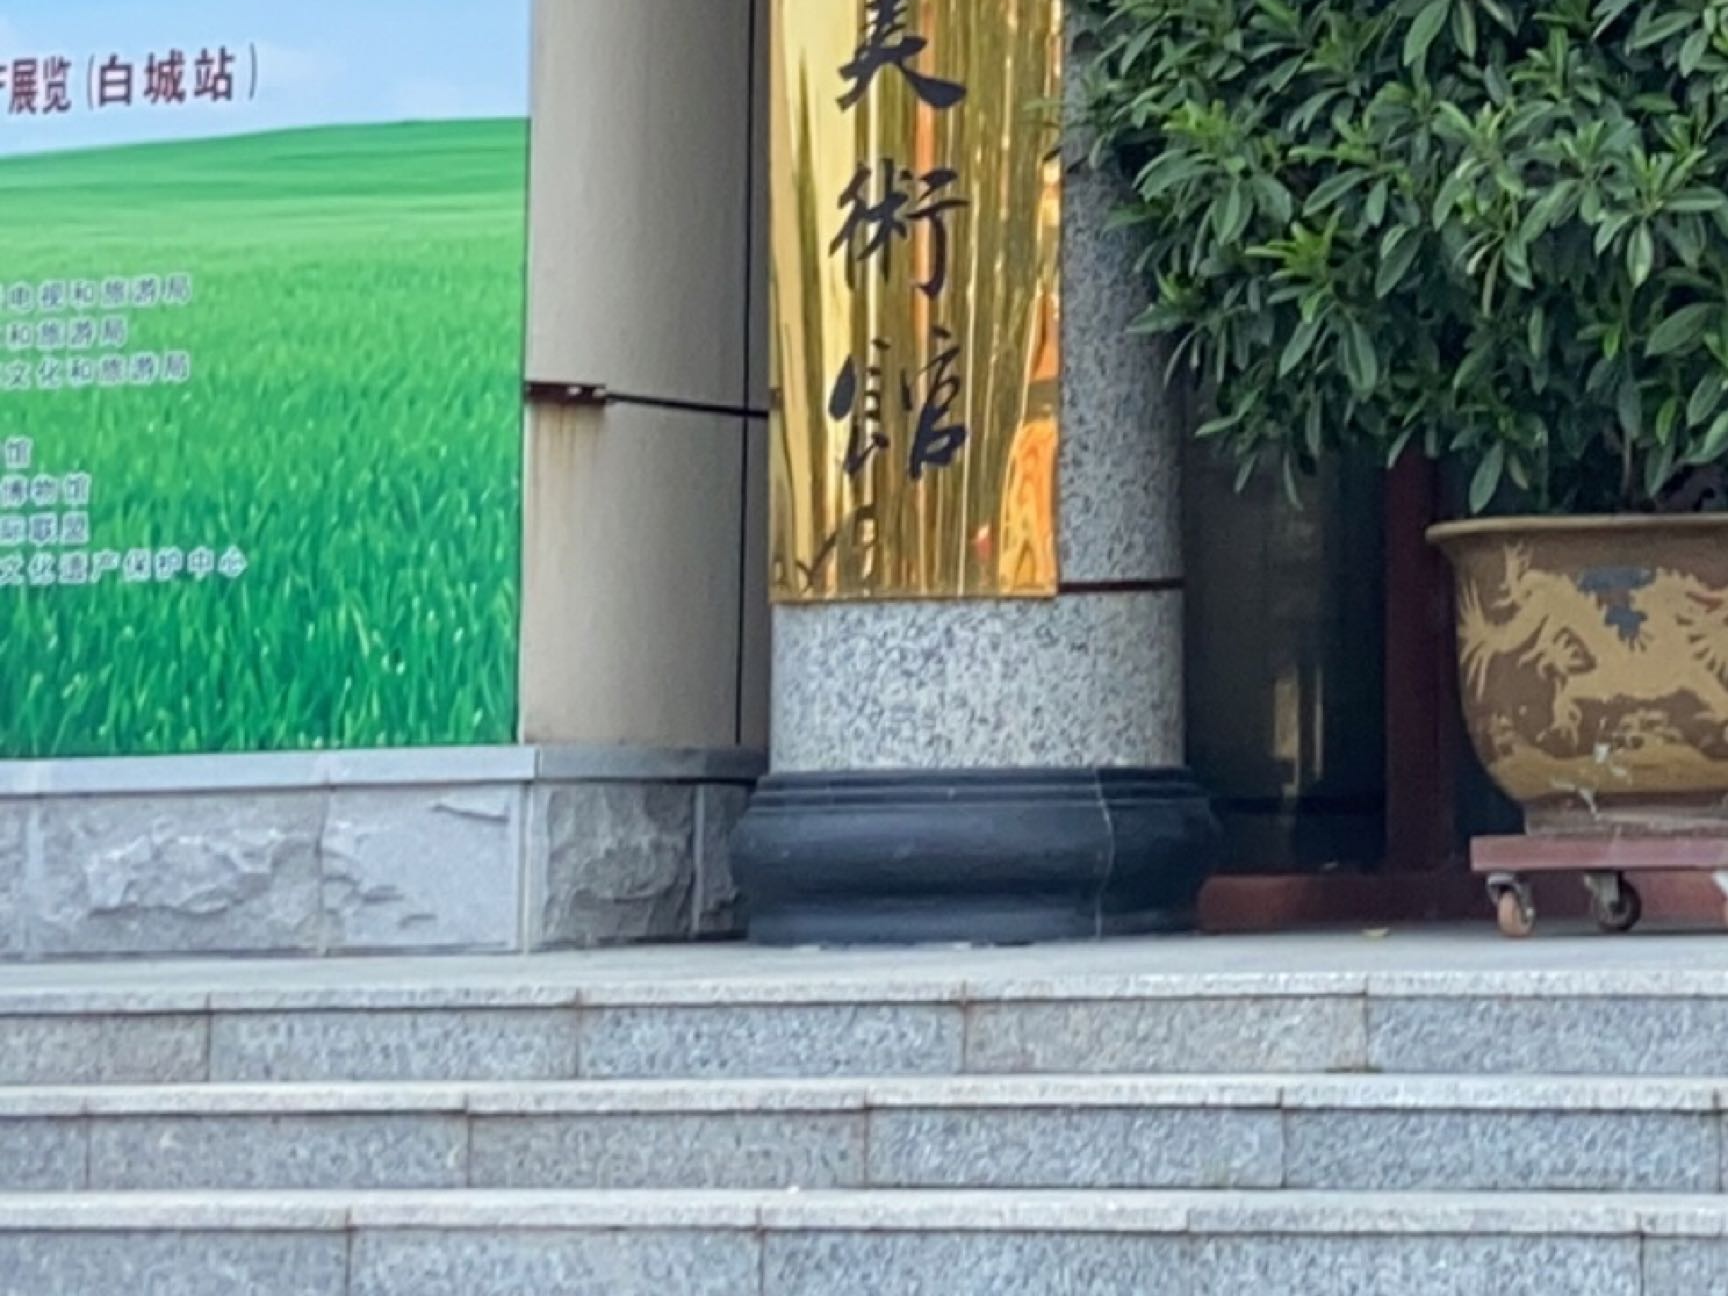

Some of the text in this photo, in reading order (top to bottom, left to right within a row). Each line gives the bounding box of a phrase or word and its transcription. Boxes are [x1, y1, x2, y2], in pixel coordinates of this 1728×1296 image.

[0, 41, 258, 114] 展览（白城站）
